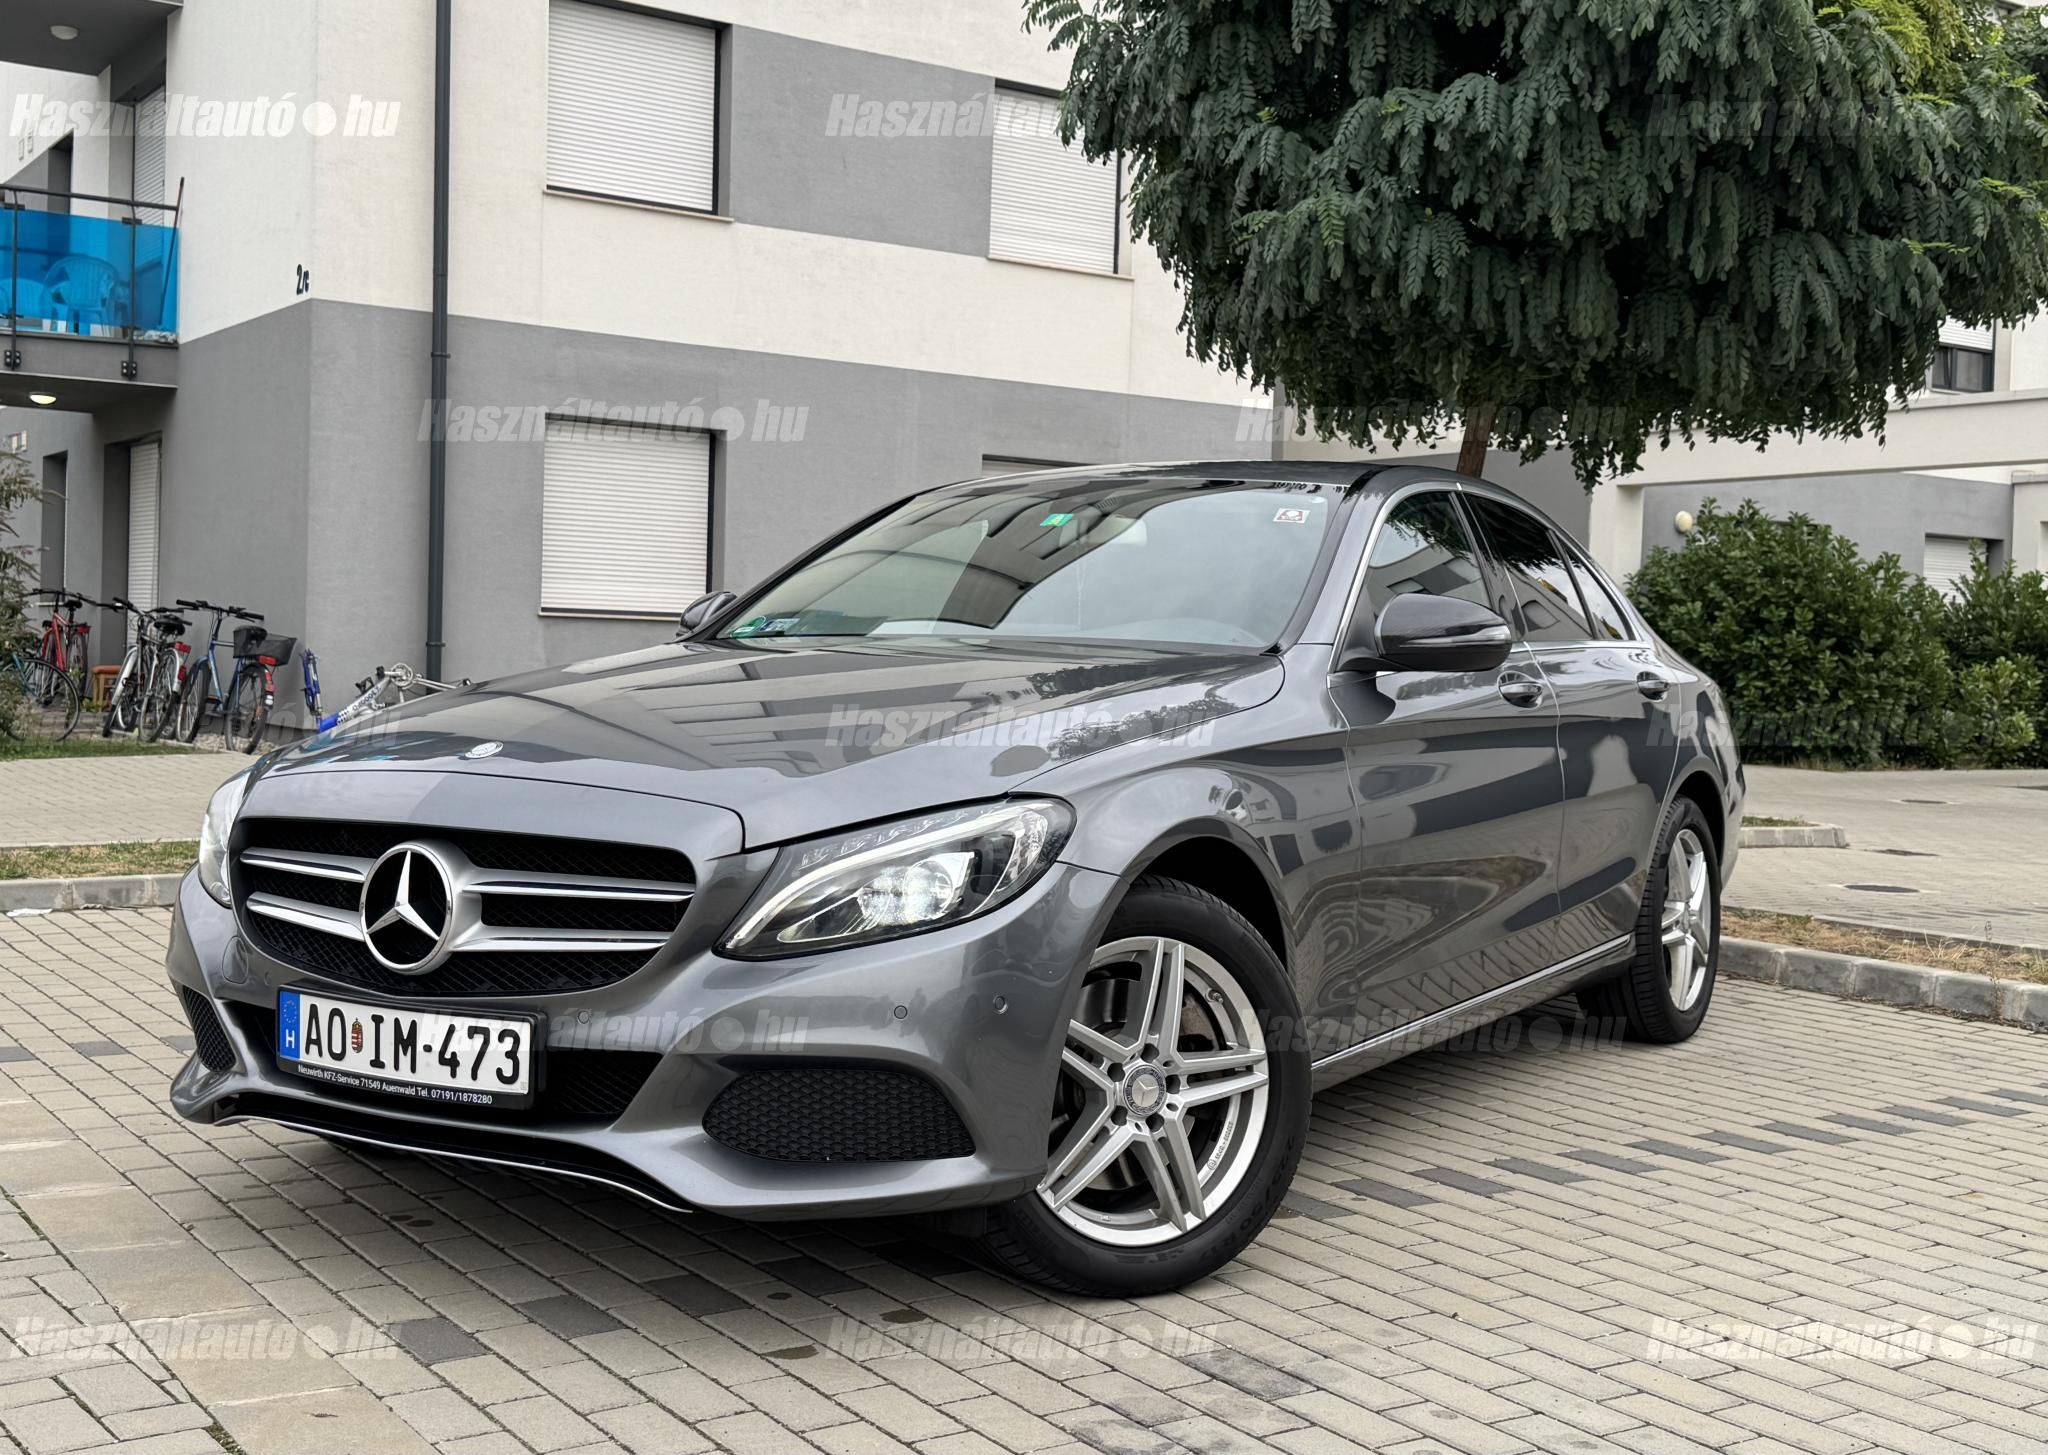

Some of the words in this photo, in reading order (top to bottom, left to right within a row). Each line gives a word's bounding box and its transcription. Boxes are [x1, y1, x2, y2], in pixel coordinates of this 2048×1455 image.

[285, 1028, 295, 1049] H
[305, 1003, 347, 1061] AO
[370, 1013, 521, 1084] IM-473
[297, 1064, 324, 1078] Neuwirth
[324, 1070, 360, 1086] KFZ-Service
[361, 1078, 381, 1090] 71549
[382, 1082, 416, 1095] Auenwald
[416, 1087, 430, 1098] Tel.
[430, 1089, 493, 1104] 07191/1878280
